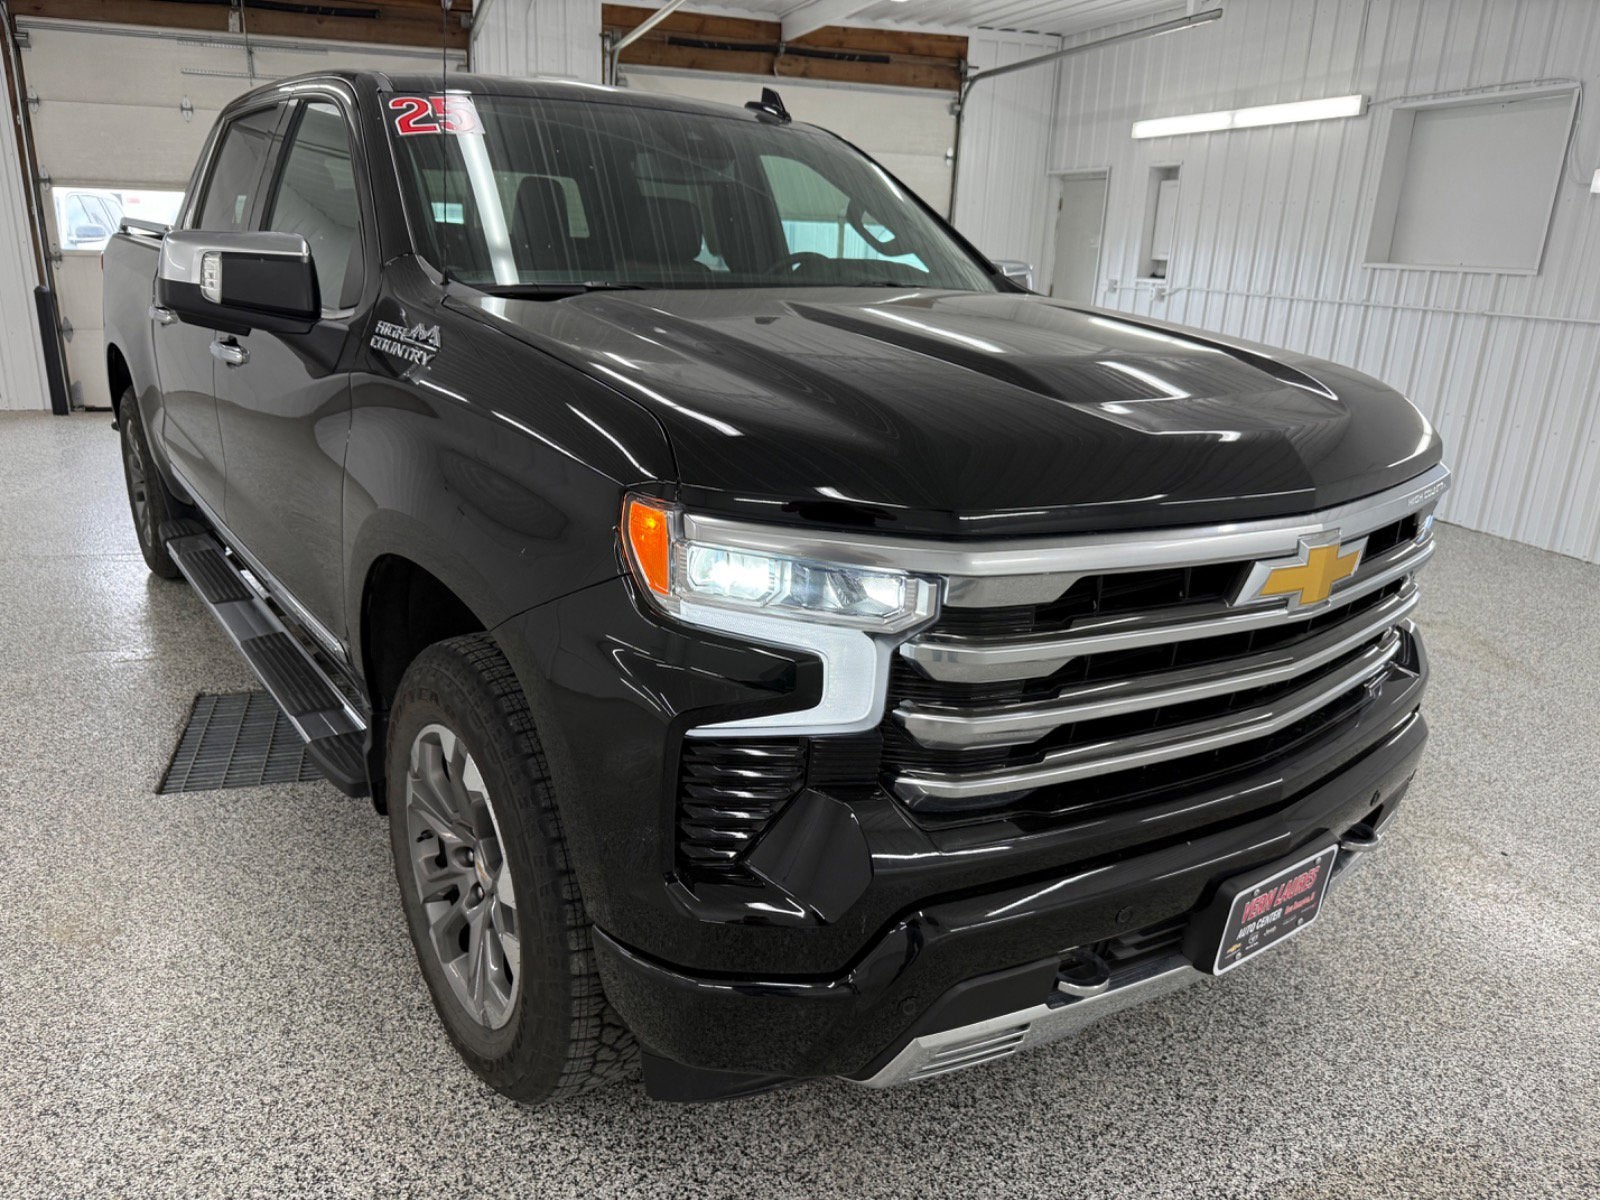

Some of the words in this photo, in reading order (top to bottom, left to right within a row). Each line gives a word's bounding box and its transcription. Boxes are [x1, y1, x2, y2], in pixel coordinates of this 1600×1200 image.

[388, 96, 479, 135] 25
[375, 320, 409, 341] HIGH
[369, 334, 436, 366] COUNTRY
[1241, 887, 1278, 924] VERN
[1274, 865, 1321, 907] LAURES
[1236, 922, 1257, 941] AUTO
[1256, 908, 1283, 930] CENTER
